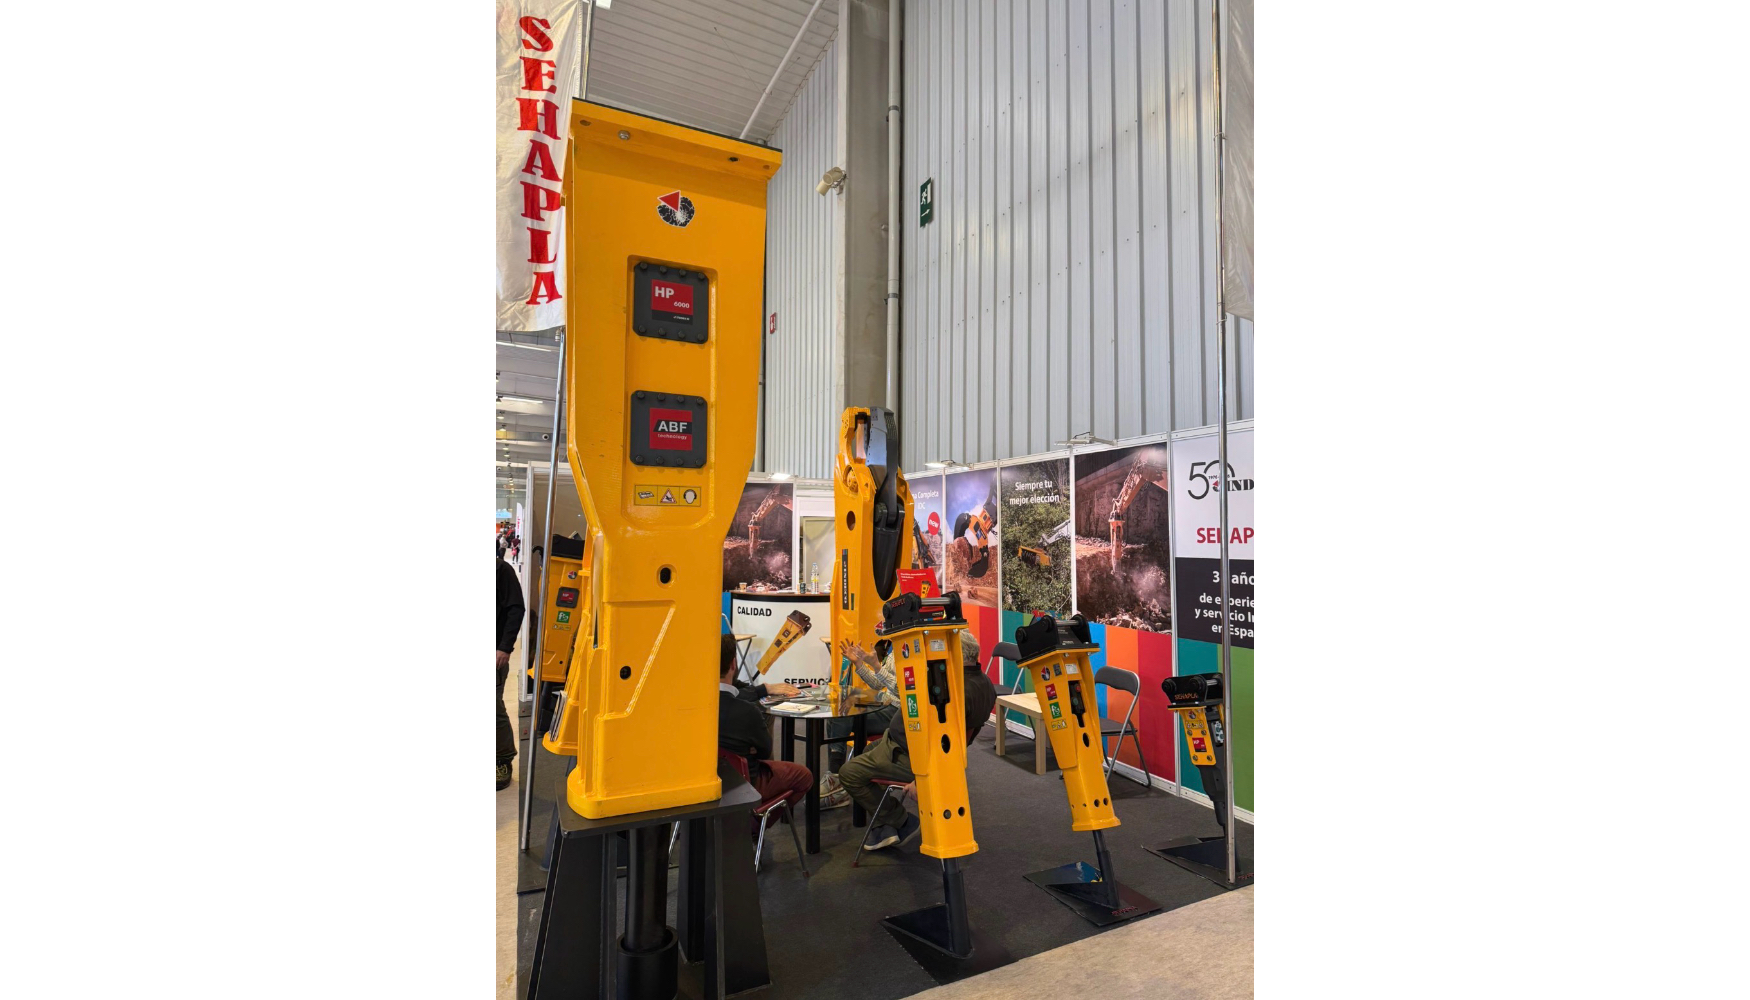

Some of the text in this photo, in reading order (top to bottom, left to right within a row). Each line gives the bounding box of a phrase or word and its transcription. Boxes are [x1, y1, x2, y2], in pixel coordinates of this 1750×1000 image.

[516, 15, 563, 306] SEHAPLA
[654, 286, 675, 299] HP
[673, 301, 690, 309] 6000
[657, 420, 688, 433] ABF
[1014, 479, 1053, 492] Siempre tu
[917, 490, 939, 500] Completa
[1009, 494, 1060, 506] mejor elección
[928, 519, 939, 528] new
[1199, 592, 1213, 604] de
[737, 606, 772, 617] CALIDAD
[1194, 607, 1201, 619] y
